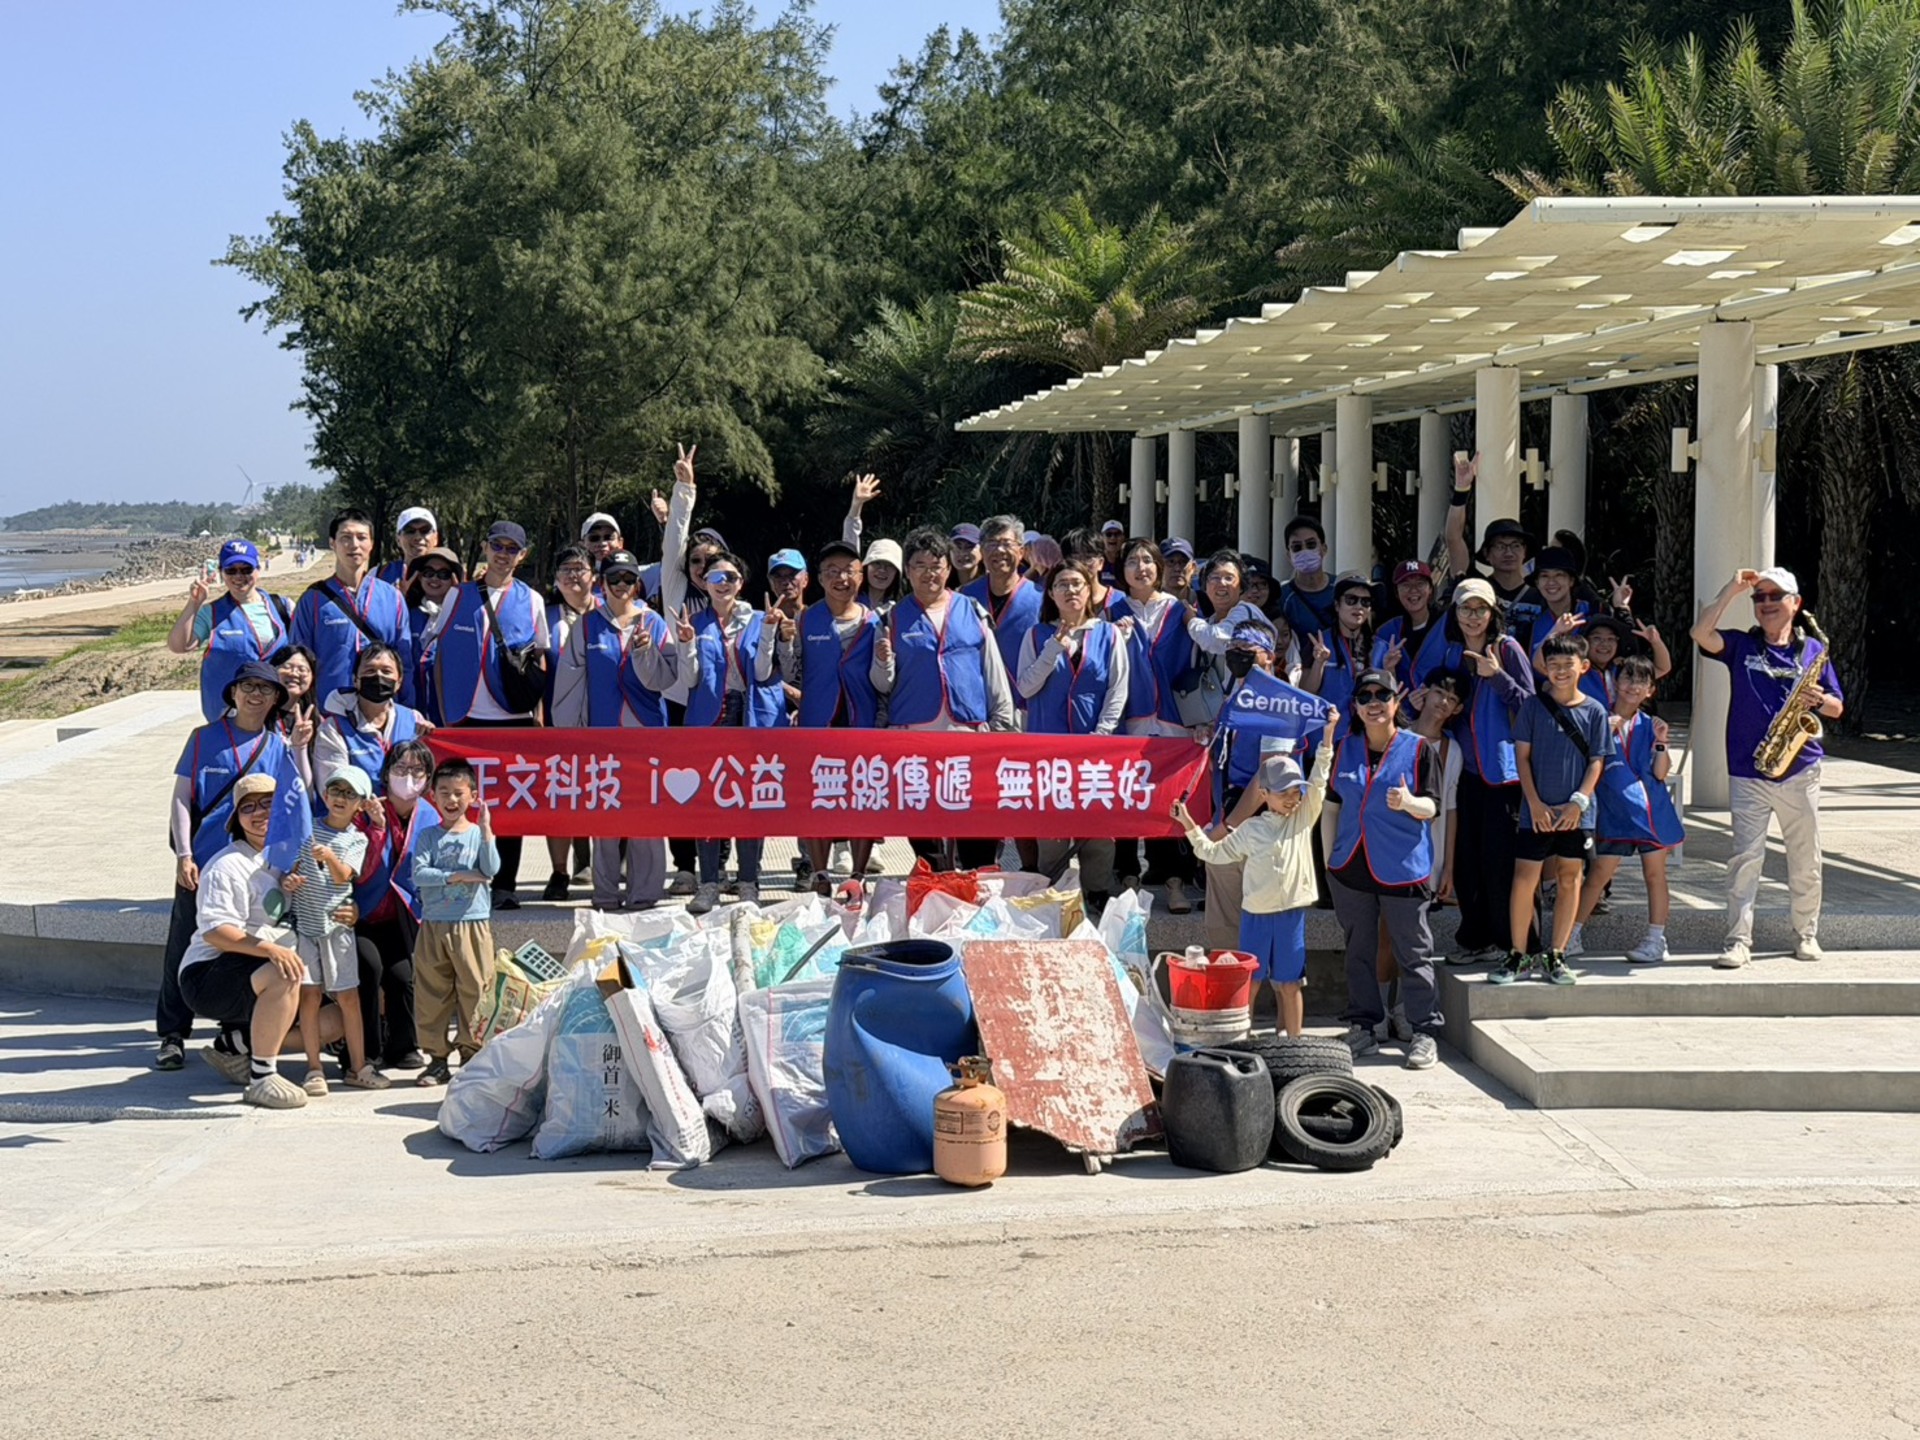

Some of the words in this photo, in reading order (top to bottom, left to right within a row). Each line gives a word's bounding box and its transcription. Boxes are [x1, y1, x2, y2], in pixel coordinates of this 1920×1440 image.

[1237, 688, 1327, 719] Gemtek
[810, 753, 972, 811] 無線傳遞
[995, 756, 1156, 812] 無限美好
